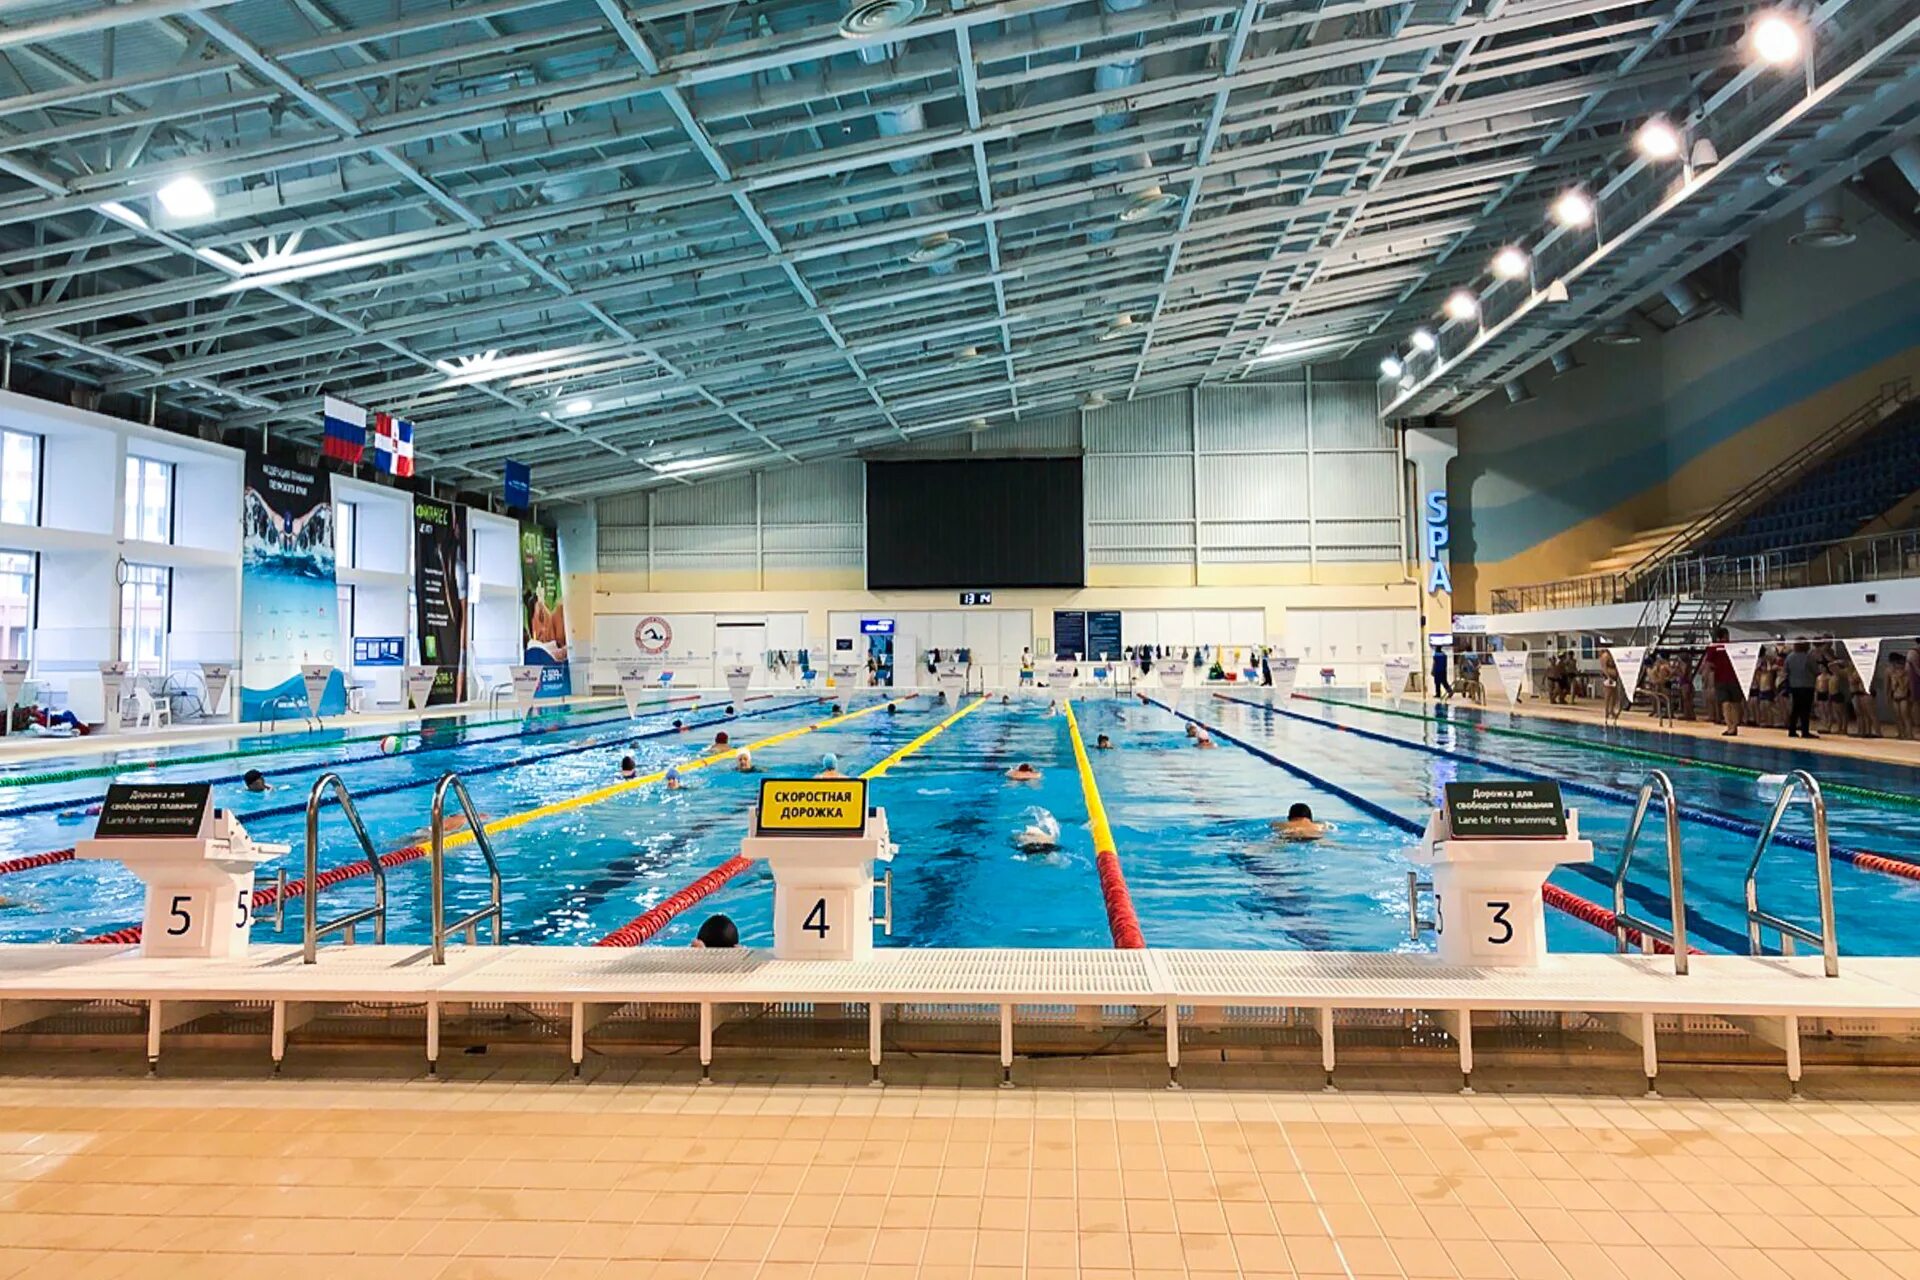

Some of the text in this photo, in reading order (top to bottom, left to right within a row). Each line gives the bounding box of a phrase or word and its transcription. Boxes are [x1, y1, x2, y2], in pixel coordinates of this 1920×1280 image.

[1426, 490, 1452, 594] SPA
[129, 790, 185, 800] Дорожка для
[774, 791, 852, 803] СКОРОСТНАЯ
[1473, 788, 1533, 799] Дорожка для
[110, 802, 158, 811] свободного
[1456, 800, 1554, 810] свободного плавания
[780, 807, 843, 820] ДОРОЖКА
[106, 815, 194, 826] Lane for free swimming
[1458, 815, 1557, 826] Lane for free swimming
[236, 890, 249, 928] 5
[167, 896, 192, 935] 5
[802, 898, 830, 939] 4
[1487, 901, 1513, 944] 3
